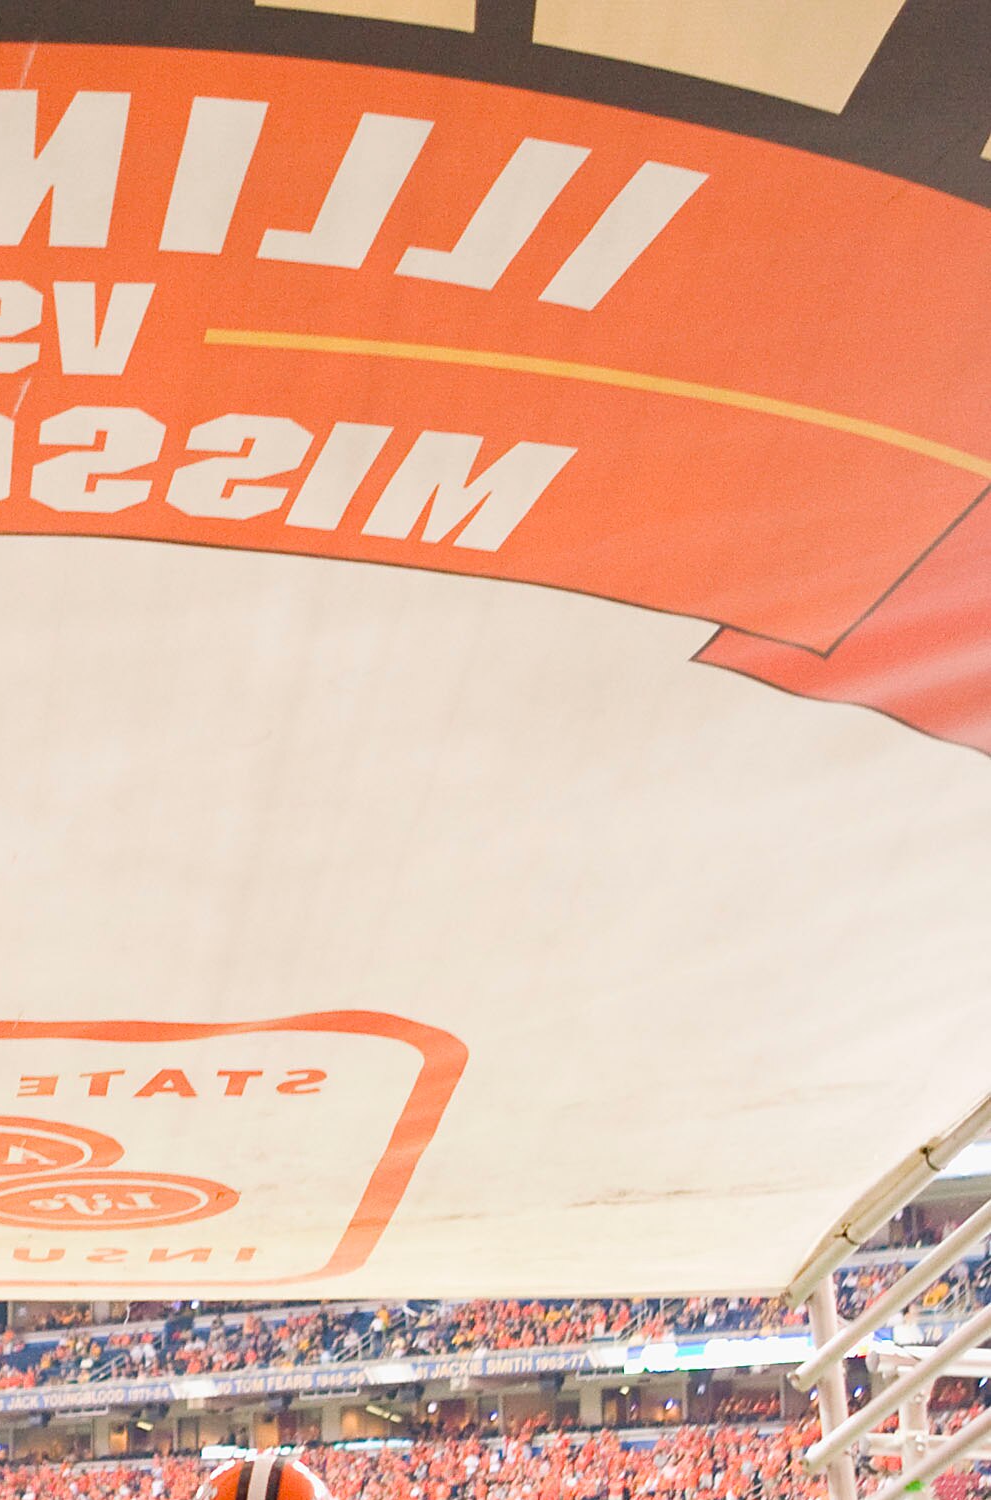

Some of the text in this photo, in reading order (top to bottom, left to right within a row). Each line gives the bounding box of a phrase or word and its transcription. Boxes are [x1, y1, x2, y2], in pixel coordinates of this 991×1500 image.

[431, 1360, 482, 1378] JACKIE
[486, 1356, 532, 1374] SMITH
[235, 1378, 264, 1393] TOM
[267, 1373, 313, 1391] FEARS
[8, 1394, 38, 1410] JACK
[42, 1388, 124, 1408] YOUNGBLOOD
